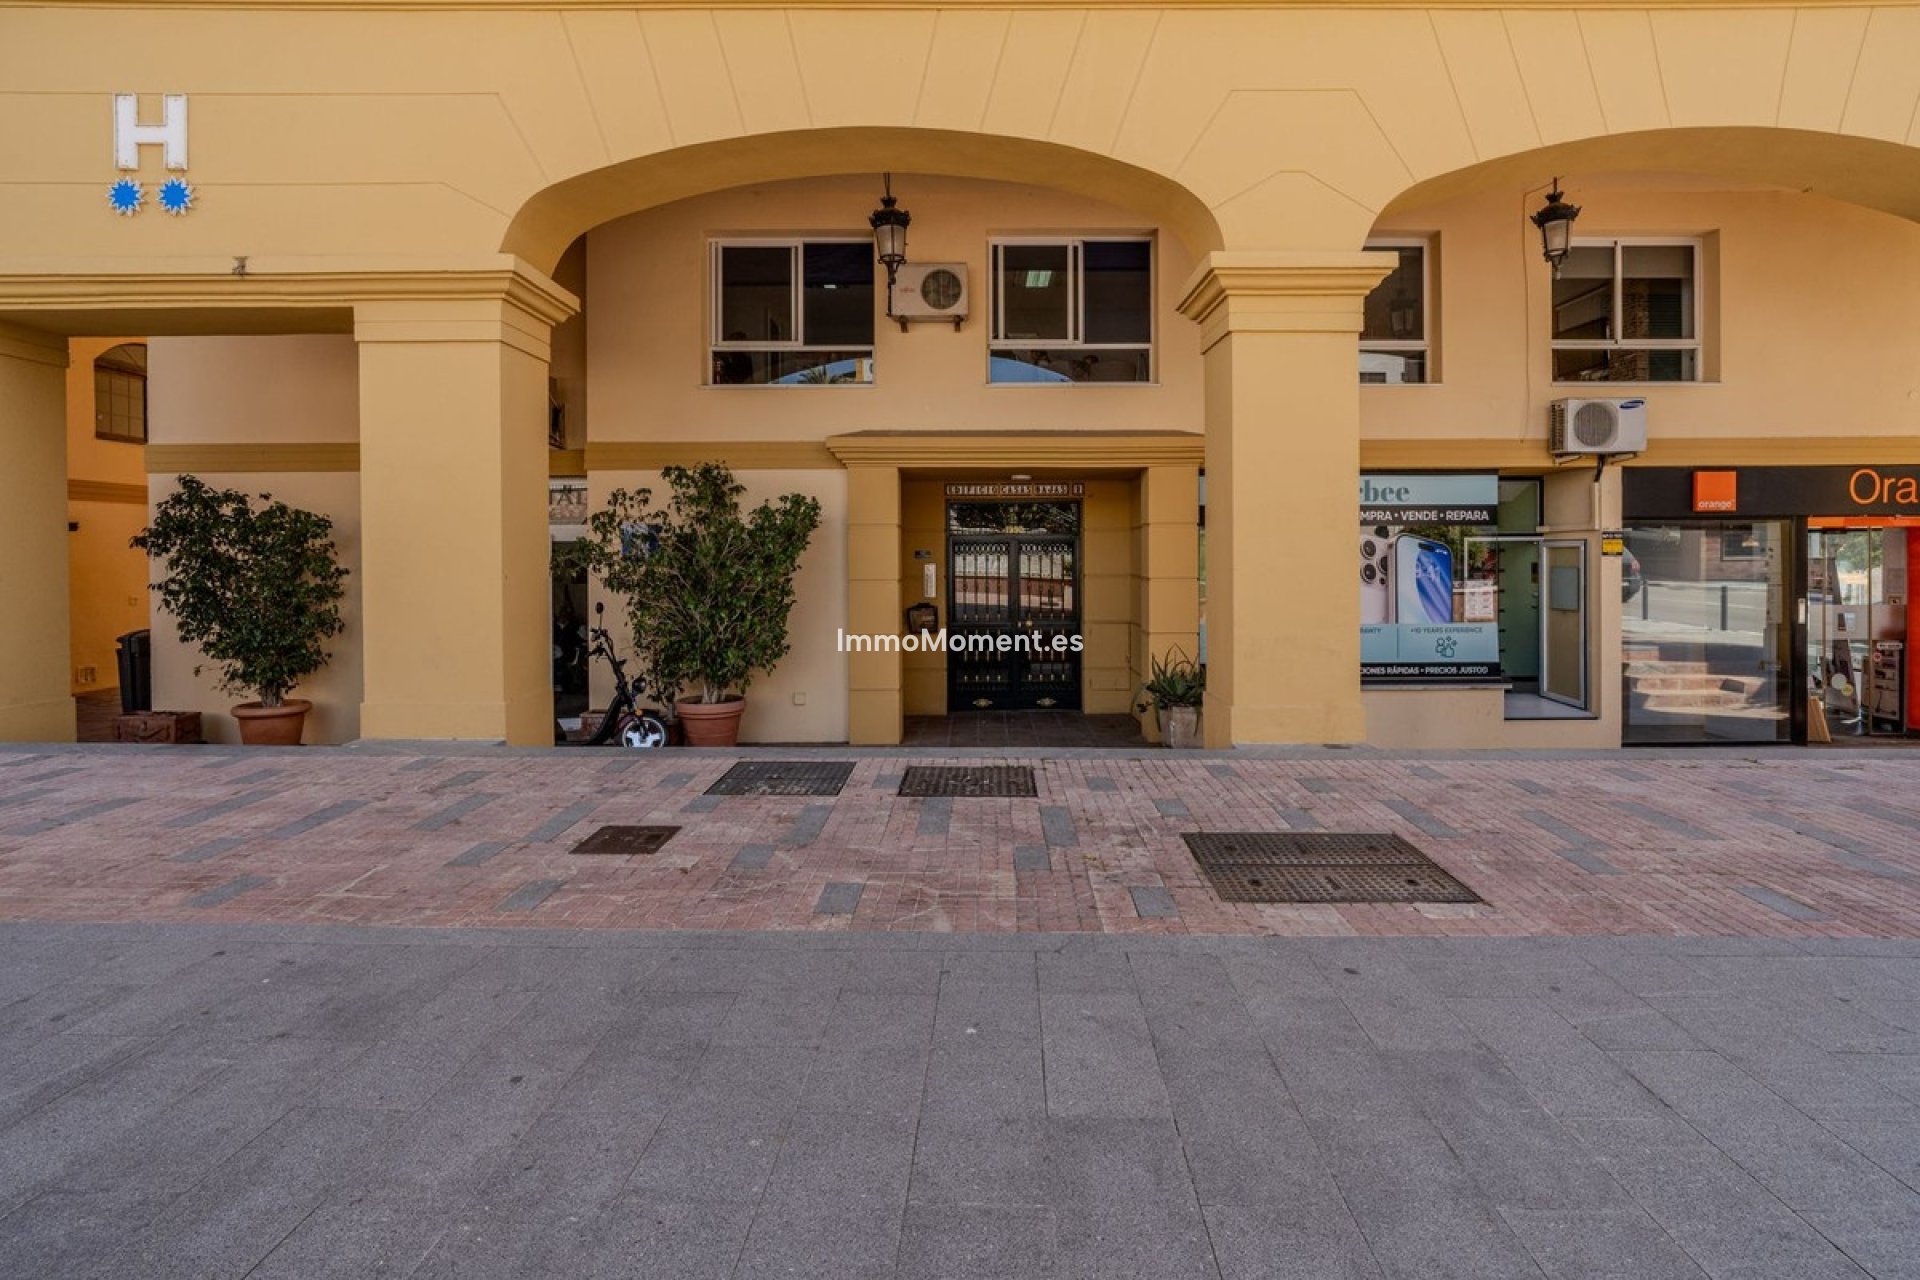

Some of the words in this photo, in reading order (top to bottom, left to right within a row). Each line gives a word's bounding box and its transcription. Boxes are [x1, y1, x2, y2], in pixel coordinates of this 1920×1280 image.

[114, 93, 189, 171] H
[1360, 480, 1410, 502] bee
[1849, 468, 1919, 505] Ora
[1698, 500, 1732, 511] orange
[1400, 510, 1438, 521] VENDE
[1446, 510, 1489, 521] REPARA
[1387, 665, 1419, 674] RÁPIDAS
[1425, 666, 1457, 674] PRECIOS
